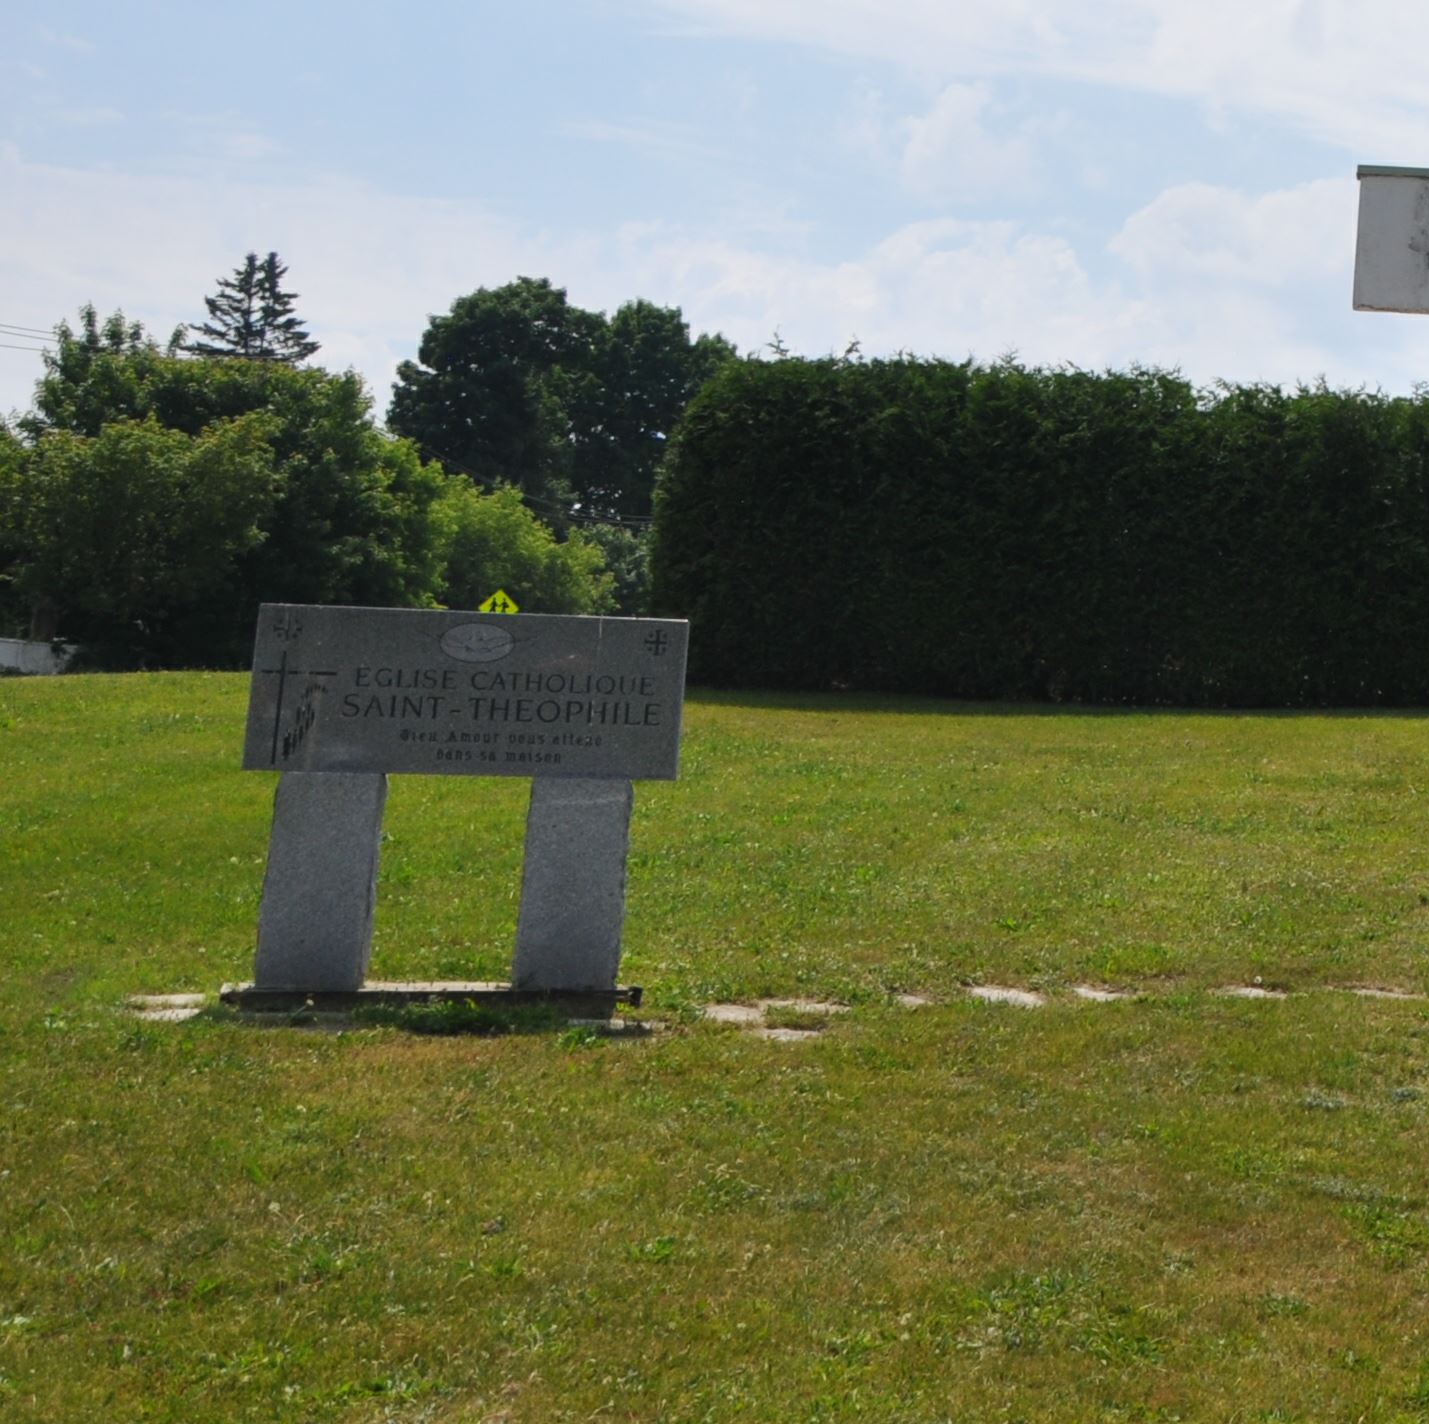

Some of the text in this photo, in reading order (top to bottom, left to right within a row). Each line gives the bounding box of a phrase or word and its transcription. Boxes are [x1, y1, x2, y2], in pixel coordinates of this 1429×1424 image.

[355, 667, 656, 697] EGLISE CATHOLIQUE
[445, 730, 499, 744] Amour
[504, 751, 561, 764] maison
